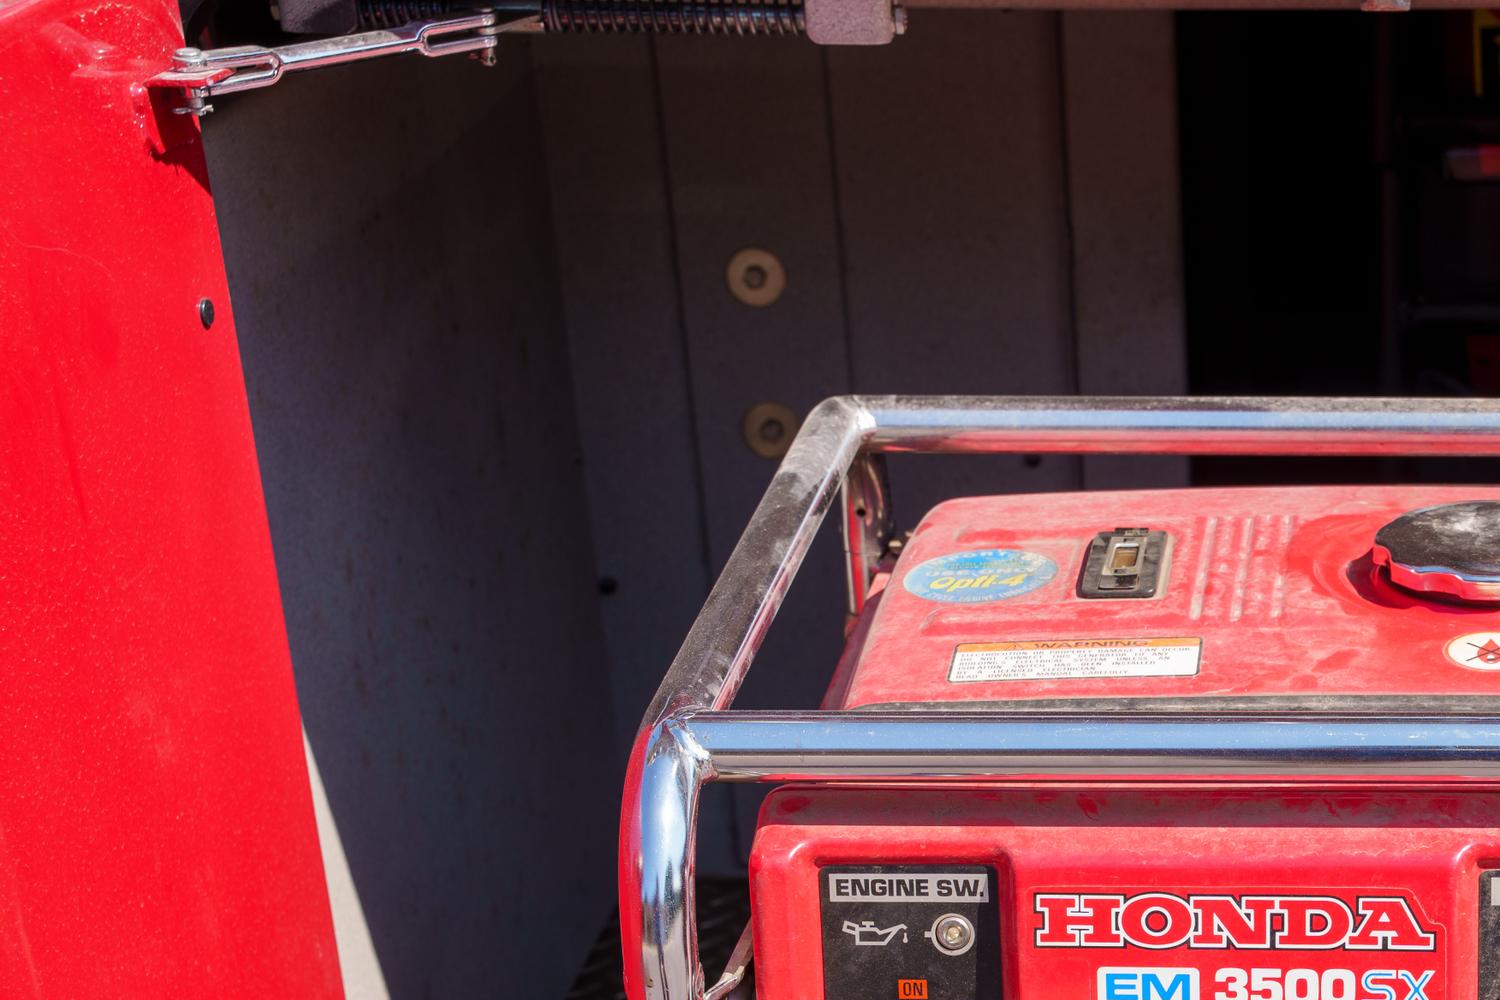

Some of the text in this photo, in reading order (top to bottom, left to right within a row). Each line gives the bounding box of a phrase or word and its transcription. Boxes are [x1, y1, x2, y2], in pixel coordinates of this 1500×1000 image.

[1035, 641, 1148, 649] WARNING
[836, 878, 985, 898] ENGINE SW.
[1035, 892, 1436, 951] HONDA
[902, 980, 924, 998] ON
